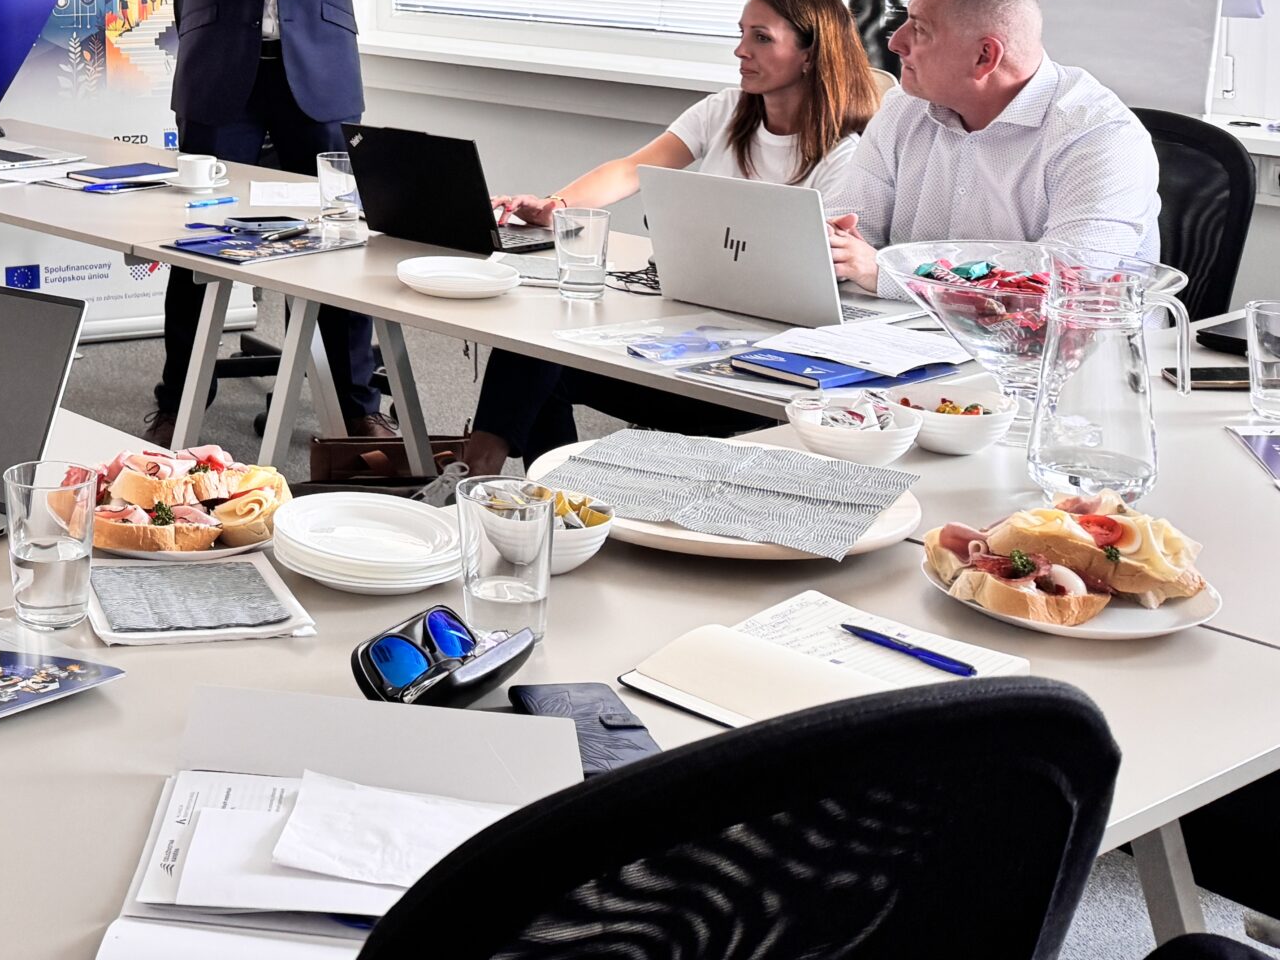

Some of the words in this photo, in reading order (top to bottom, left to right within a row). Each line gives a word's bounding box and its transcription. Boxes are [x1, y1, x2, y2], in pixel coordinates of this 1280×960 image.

[723, 226, 746, 262] hp
[44, 262, 112, 275] Spolufinancovaný
[44, 273, 86, 285] Európskou
[87, 271, 110, 281] úniou
